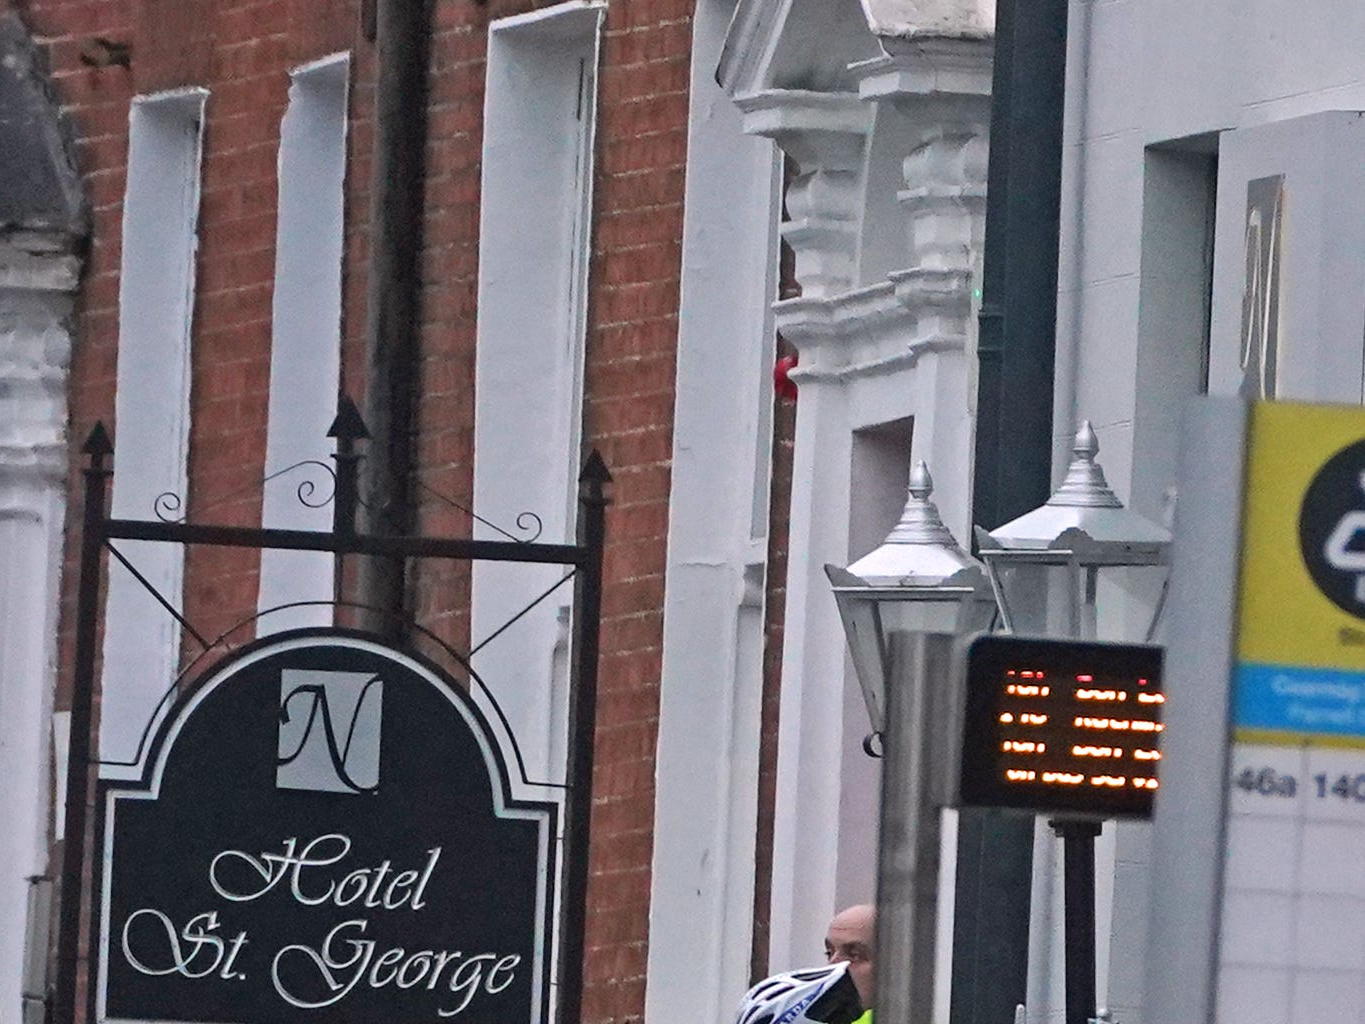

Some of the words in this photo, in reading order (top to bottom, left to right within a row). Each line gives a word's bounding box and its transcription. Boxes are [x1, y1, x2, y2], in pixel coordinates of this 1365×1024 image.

[1237, 766, 1297, 798] 46a
[209, 833, 442, 911] Hotel
[122, 908, 248, 981] St.
[271, 918, 523, 1018] George
